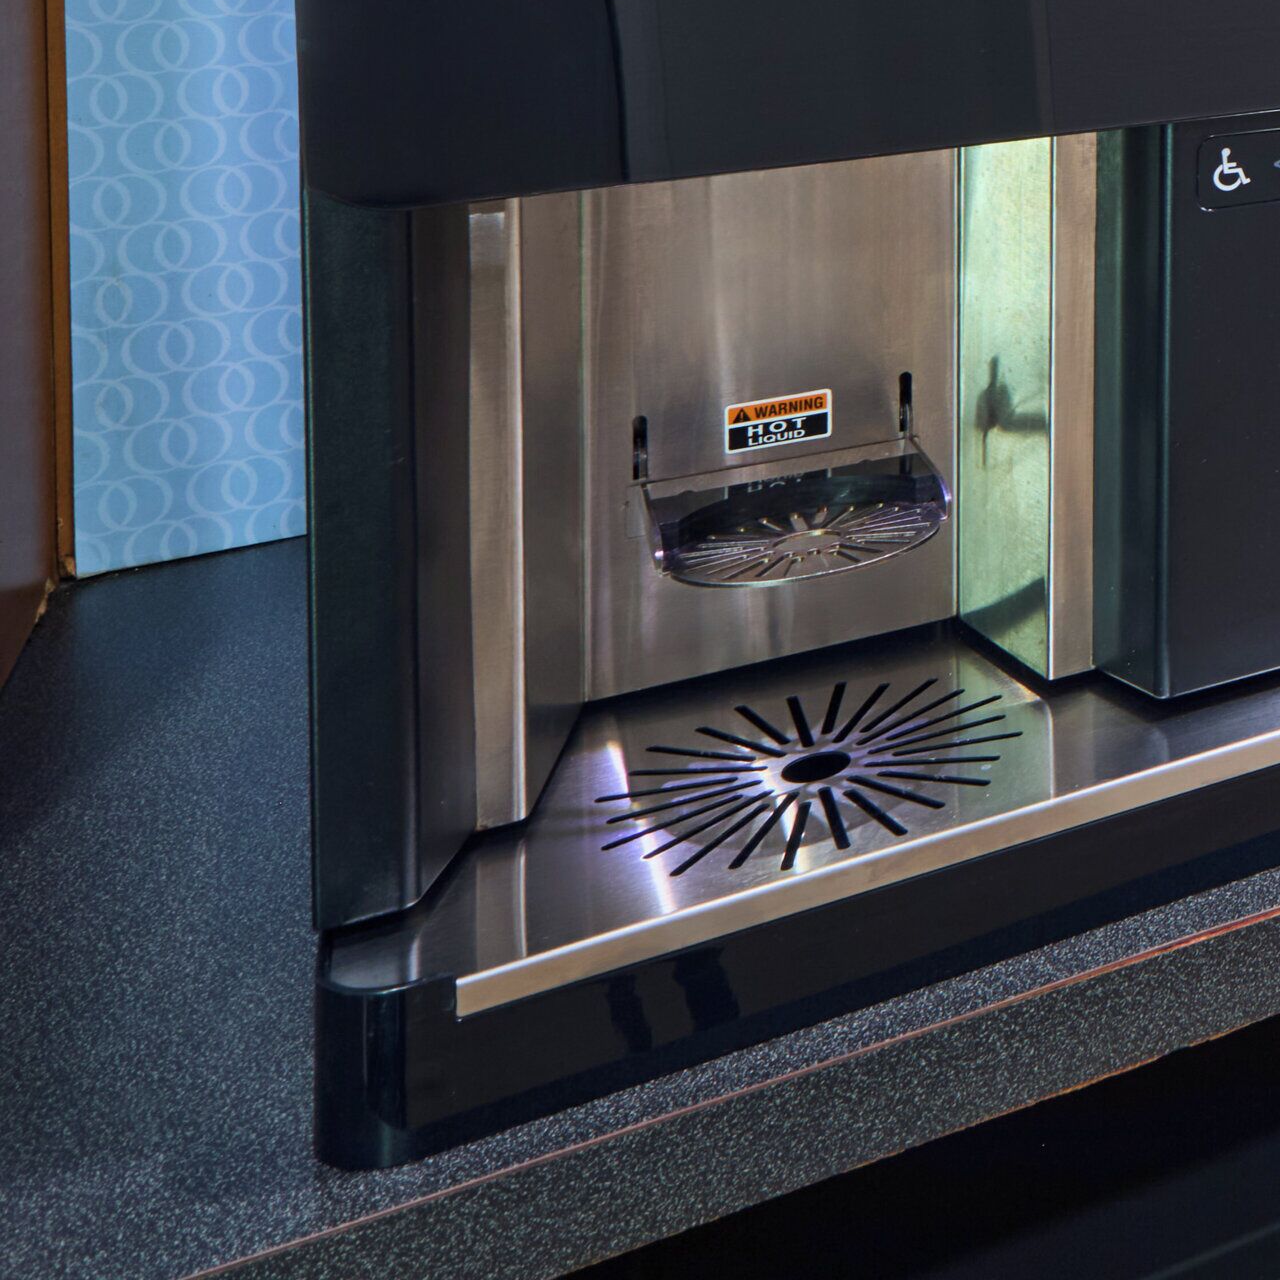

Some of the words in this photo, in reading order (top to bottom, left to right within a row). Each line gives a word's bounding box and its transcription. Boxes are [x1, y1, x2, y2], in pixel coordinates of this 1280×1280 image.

[754, 396, 823, 418] WARNING
[748, 417, 807, 437] HOT
[748, 429, 805, 446] LIQUID
